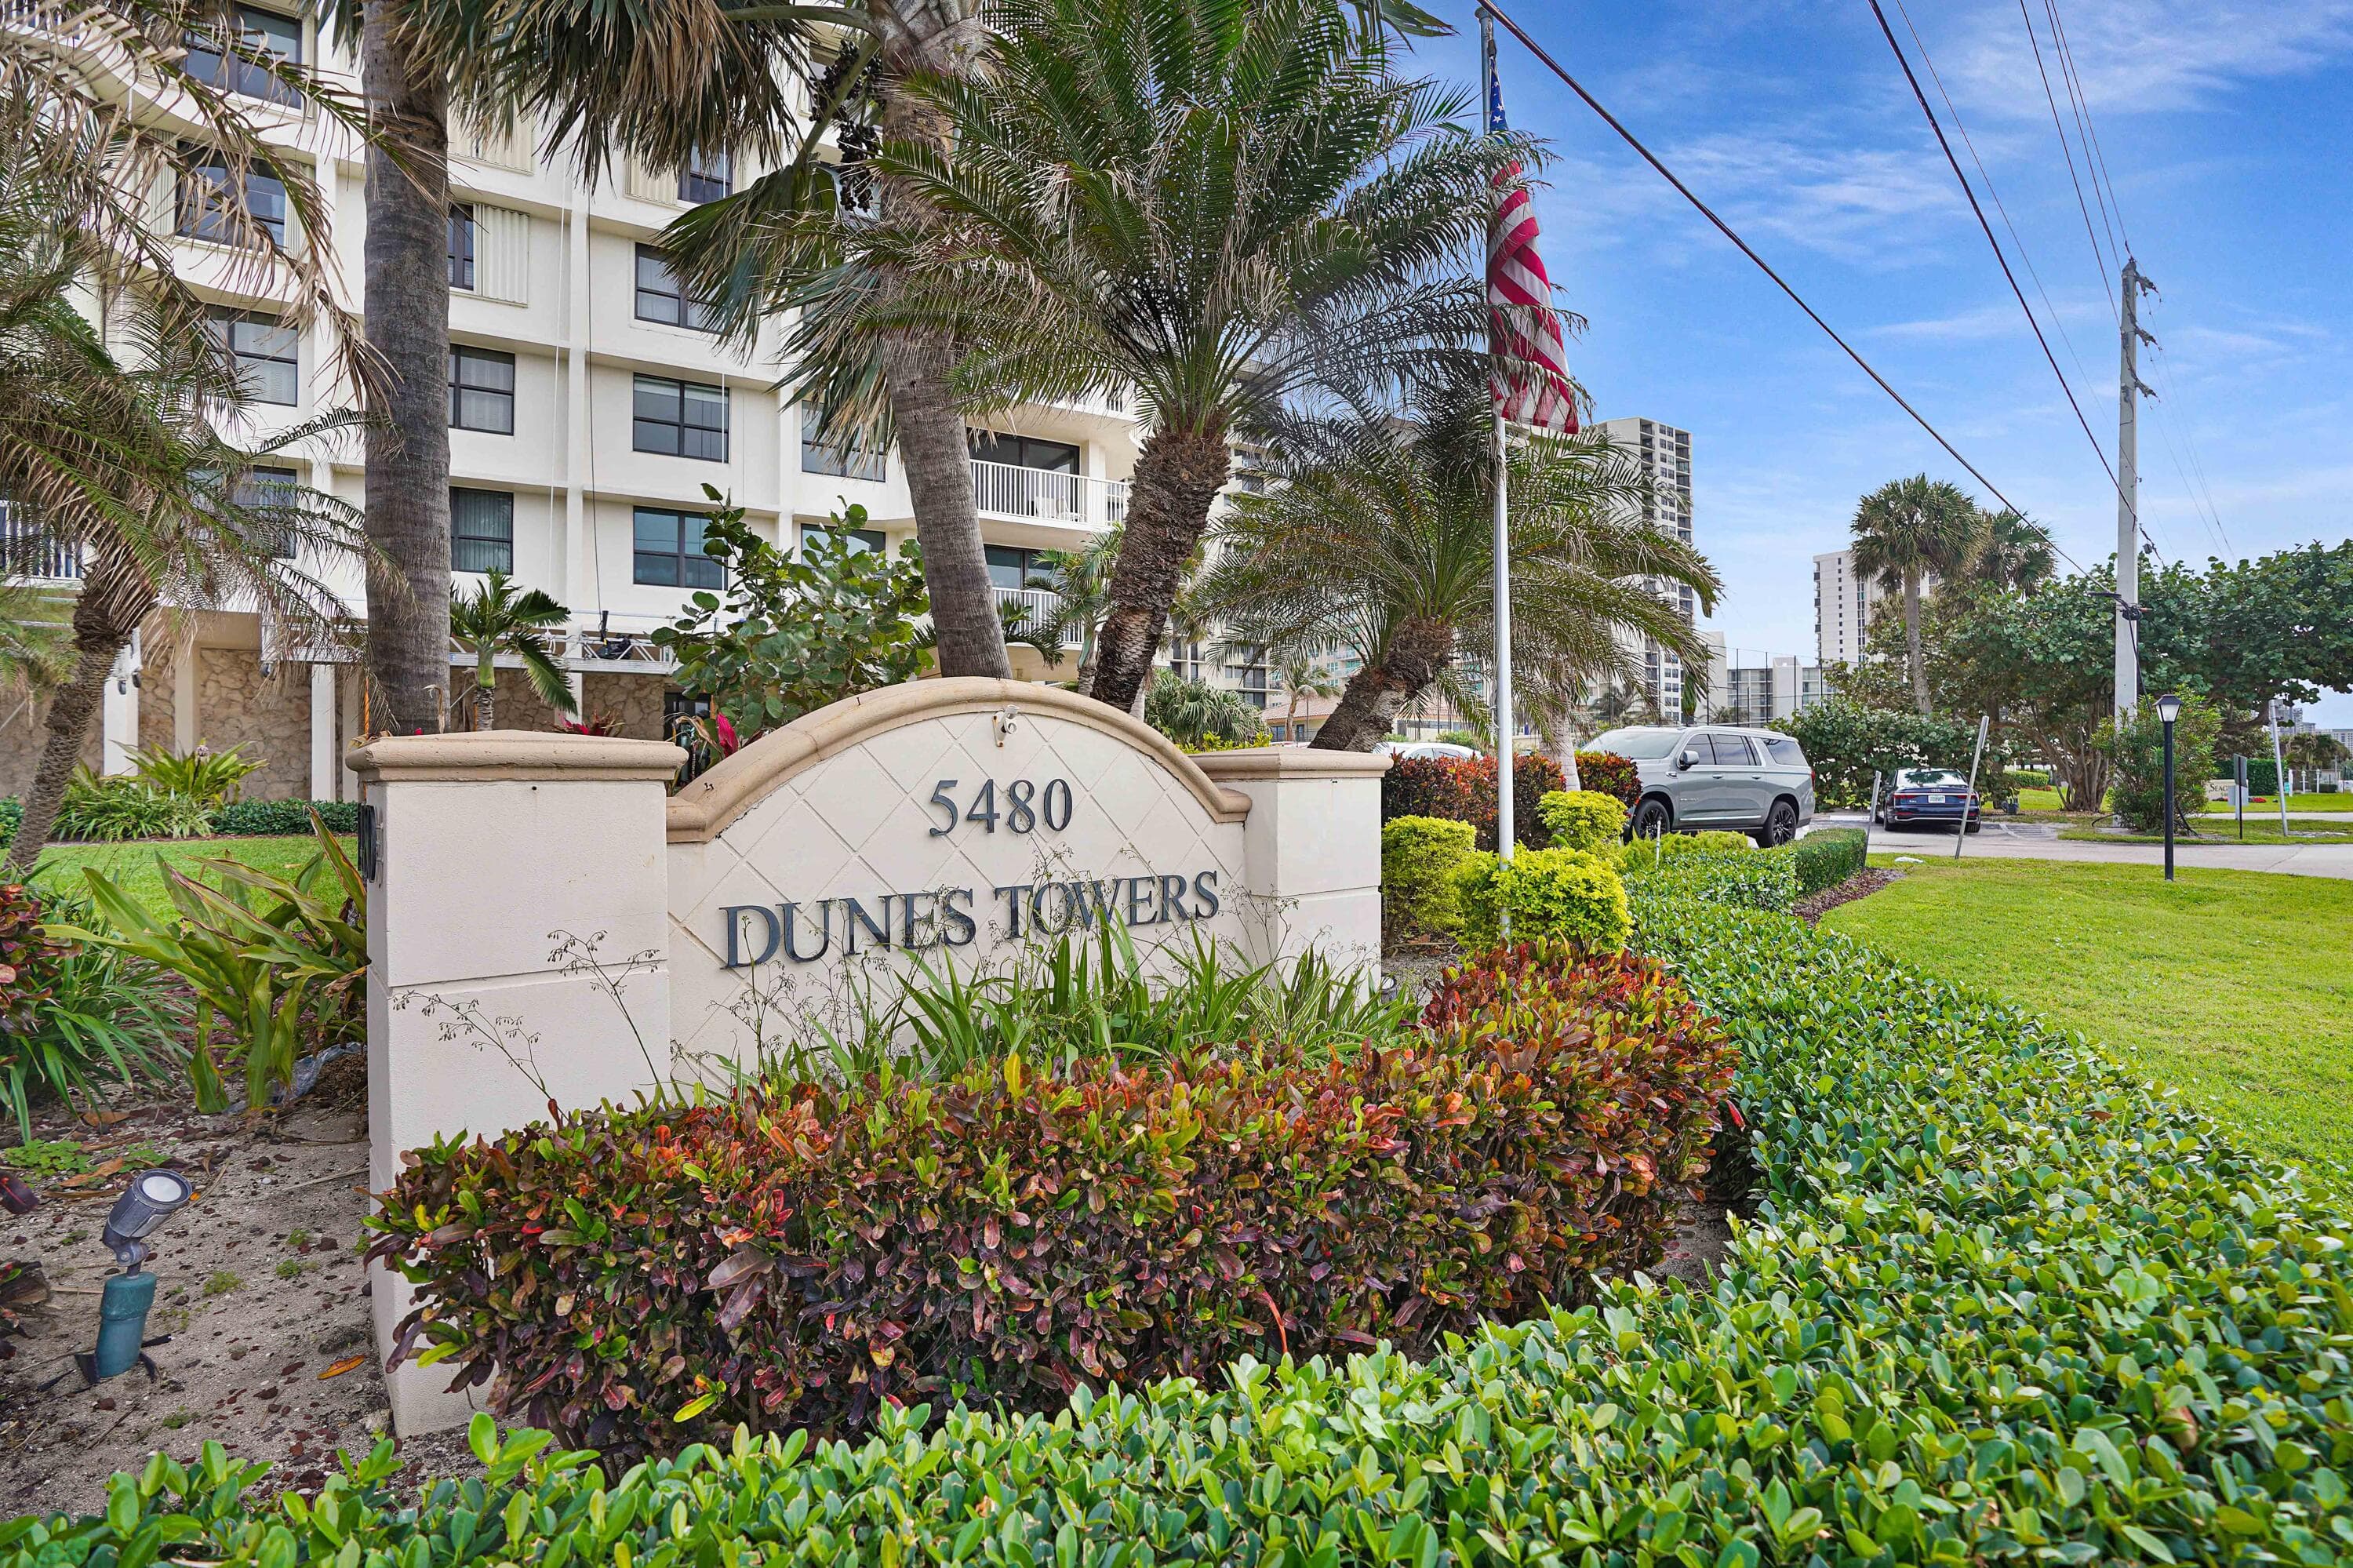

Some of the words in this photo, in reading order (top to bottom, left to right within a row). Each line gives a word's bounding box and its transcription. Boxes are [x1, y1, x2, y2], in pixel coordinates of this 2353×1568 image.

[929, 778, 1072, 836] 5480
[718, 888, 976, 970] DUNES
[995, 870, 1219, 939] TOWERS
